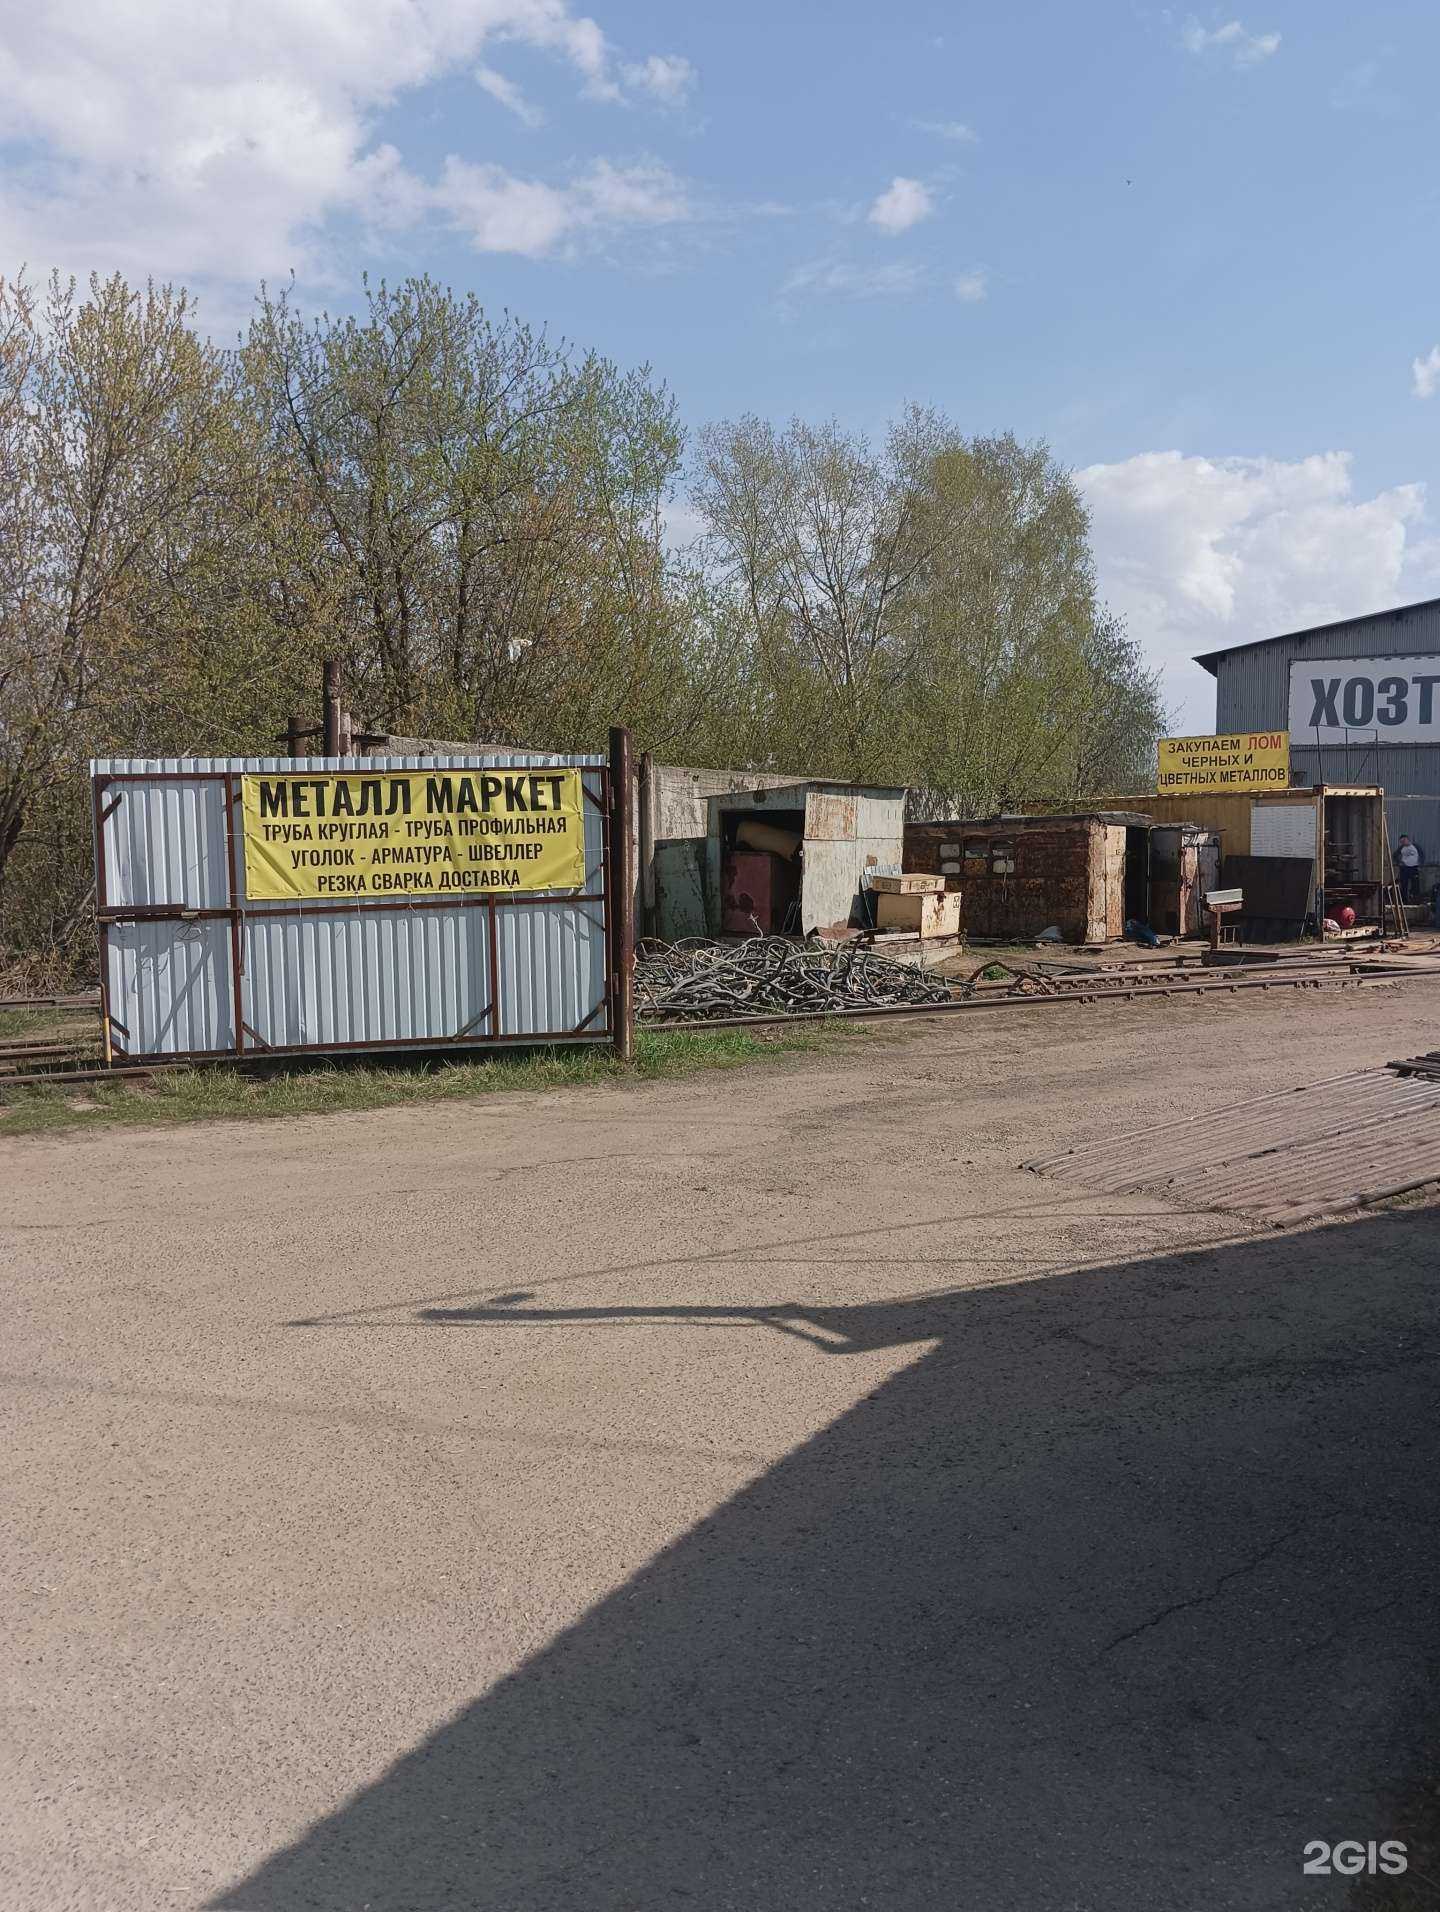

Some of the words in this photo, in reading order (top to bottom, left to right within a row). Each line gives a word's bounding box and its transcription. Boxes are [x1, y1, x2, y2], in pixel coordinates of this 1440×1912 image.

[1168, 739, 1240, 753] ЗАКУПАЕМ
[1248, 735, 1282, 749] ЛОМ
[1182, 755, 1240, 768] ЧЕРНЫХ
[1244, 754, 1253, 764] И
[1160, 772, 1216, 786] ЦВЕТНЫХ
[1220, 769, 1285, 783] МЕТАЛЛОВ
[259, 779, 411, 818] МЕТАЛЛ
[426, 776, 565, 815] МАРКЕТ
[262, 824, 312, 841] ТРУБА
[318, 822, 389, 840] КРУГЛАЯ
[405, 820, 453, 837] ТРУБА
[458, 817, 567, 836] ПРОФИЛЬНАЯ
[292, 849, 354, 869] УГОЛОК
[372, 846, 452, 864] АРМАТУРА
[469, 844, 543, 862] ШВЕЛЛЕР
[318, 875, 367, 891] РЕЗКА
[372, 873, 433, 890] СВАРКА
[439, 870, 520, 889] ДОСТАВКА
